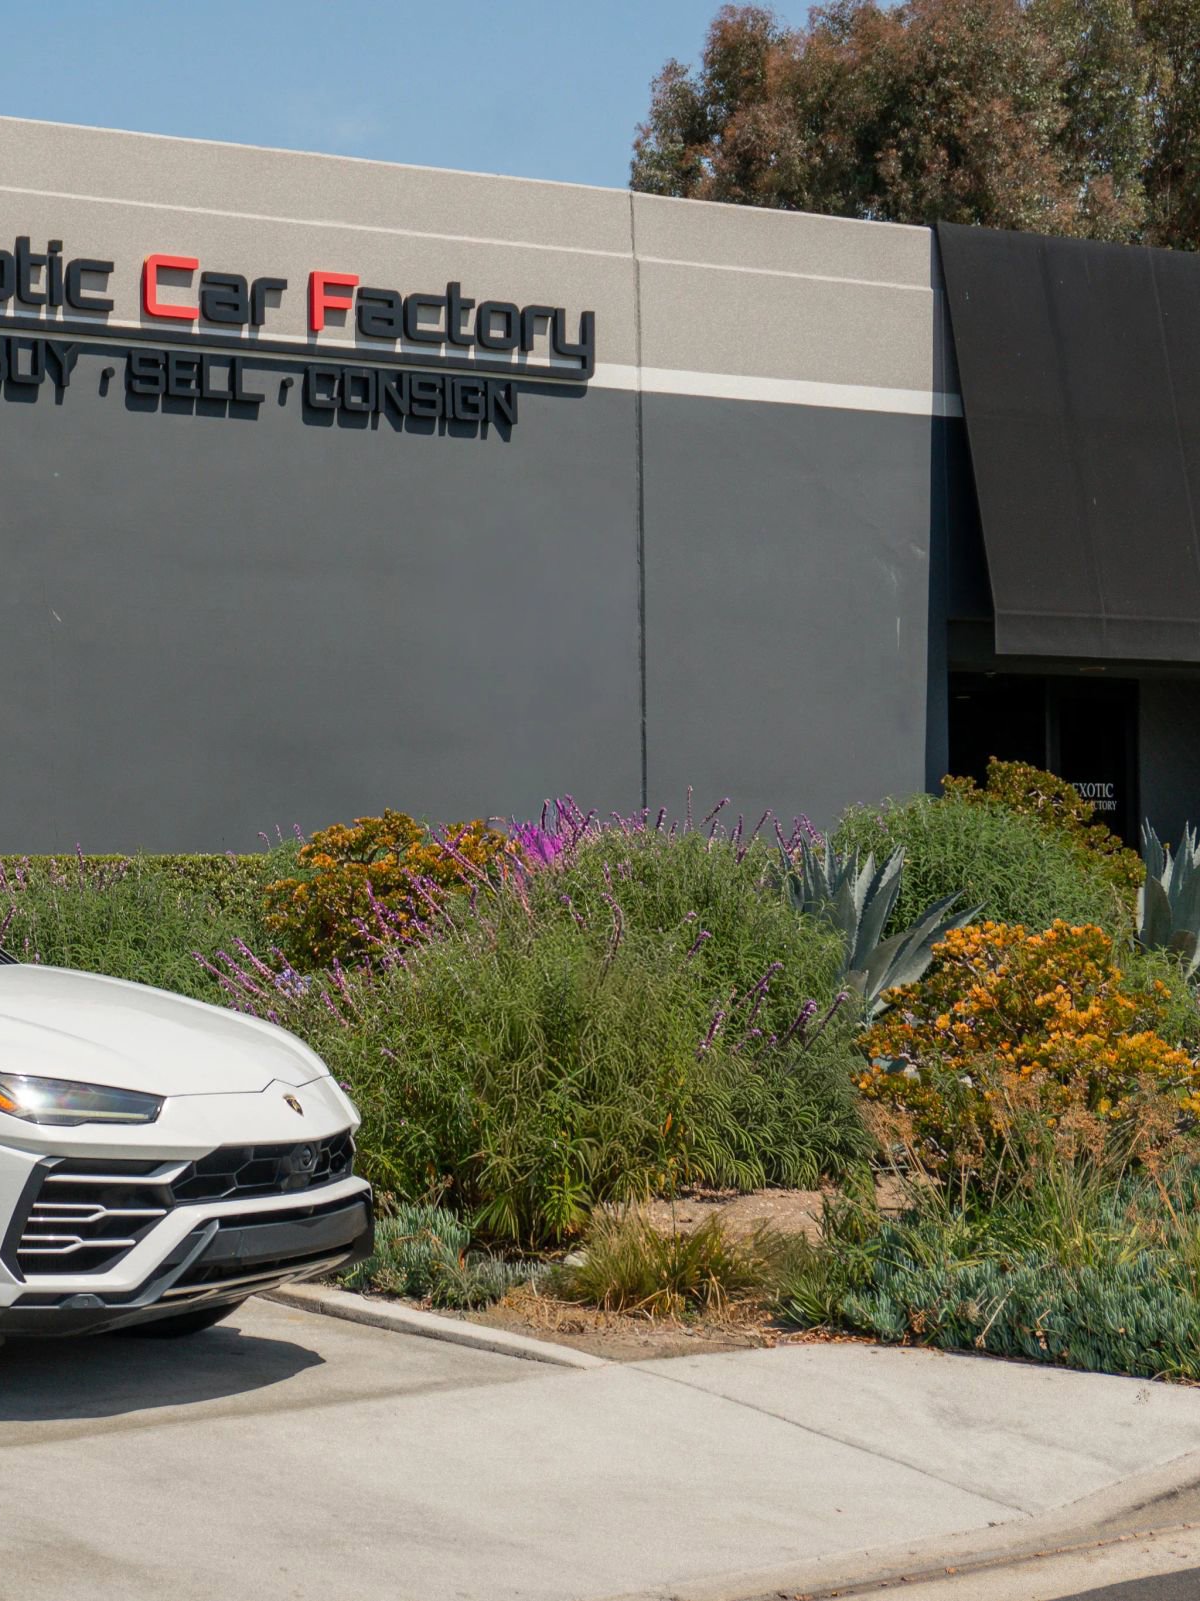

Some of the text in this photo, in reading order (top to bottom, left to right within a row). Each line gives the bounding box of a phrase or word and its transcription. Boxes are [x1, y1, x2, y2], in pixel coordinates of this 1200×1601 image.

[143, 254, 288, 326] Car
[309, 271, 596, 380] Factory
[130, 349, 265, 403] SELL
[306, 365, 519, 426] CONSIGN
[1072, 782, 1114, 798] EXOTIC
